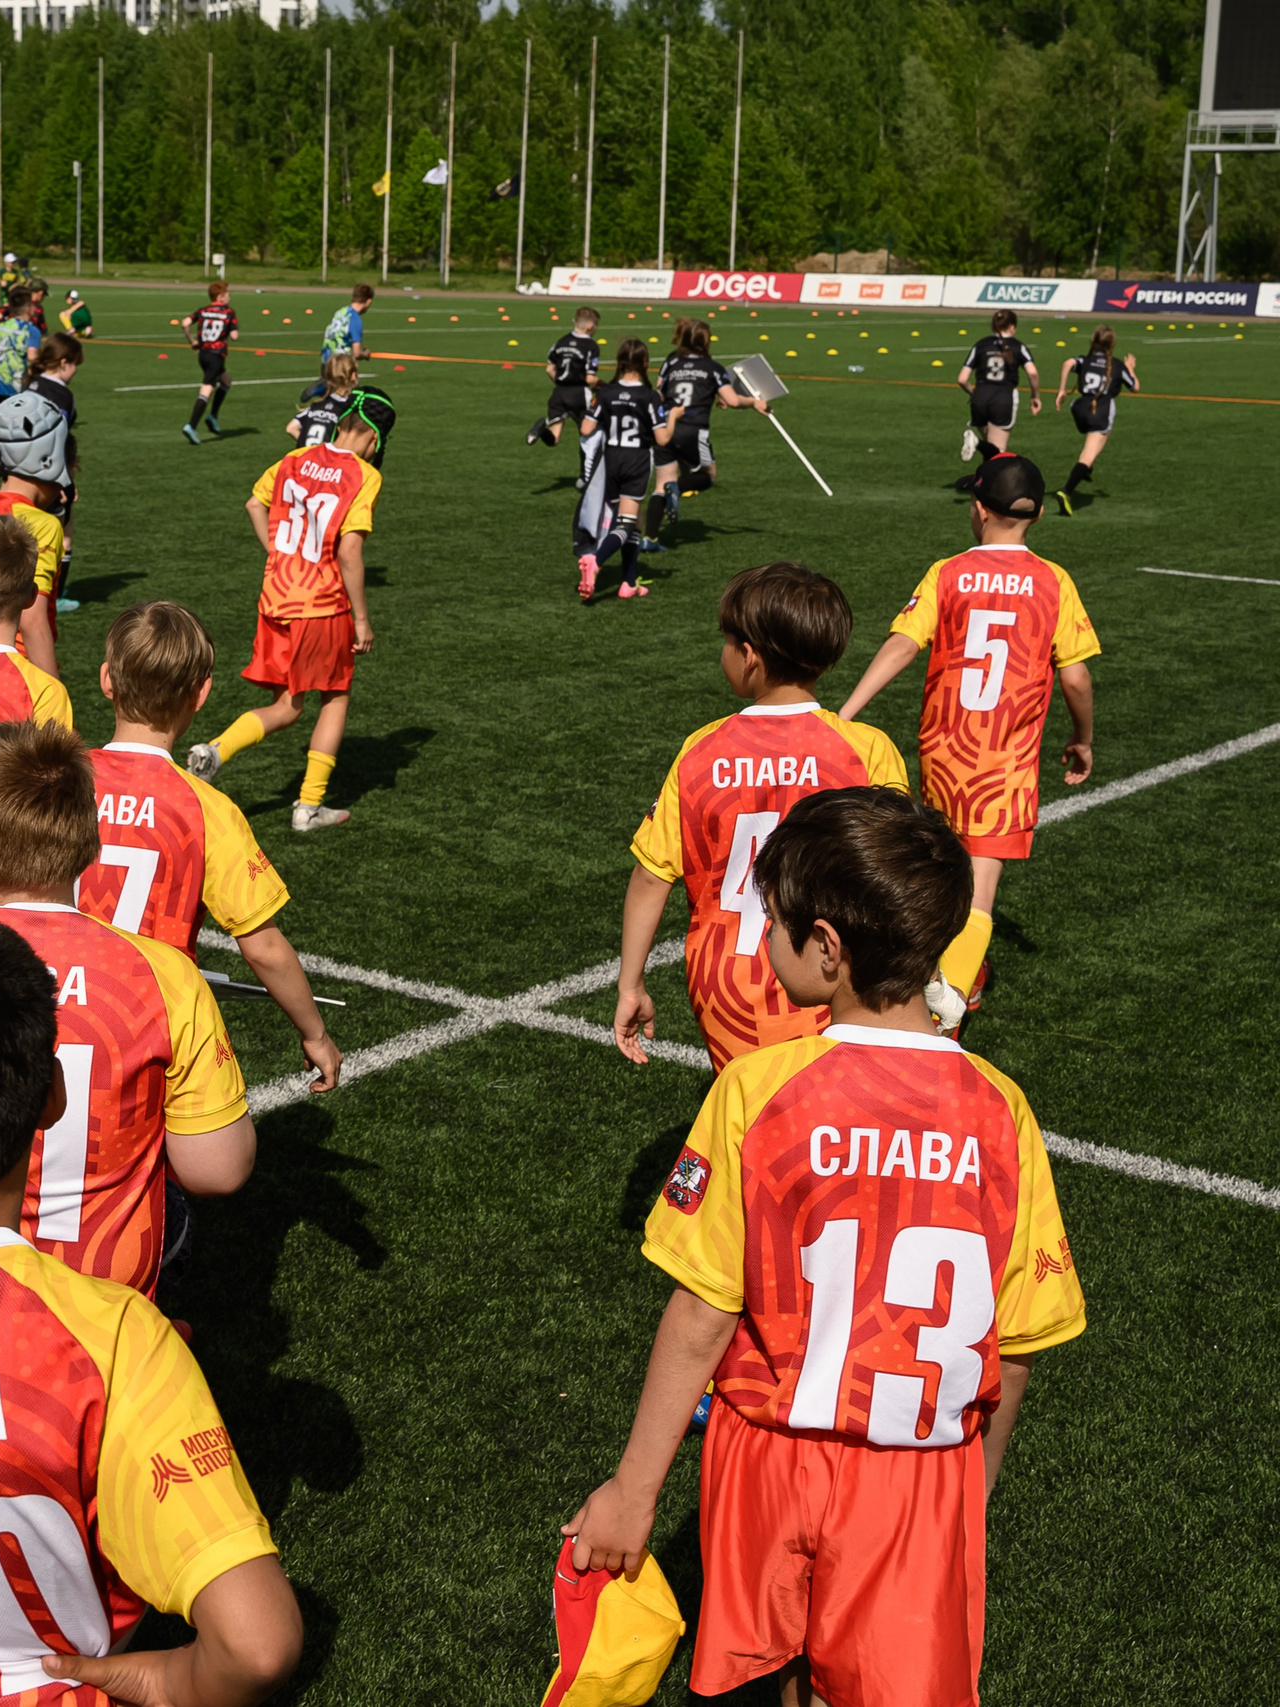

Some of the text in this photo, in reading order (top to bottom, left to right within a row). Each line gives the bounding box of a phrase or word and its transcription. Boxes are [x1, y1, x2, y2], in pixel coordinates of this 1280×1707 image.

[985, 284, 1051, 302] LANCET
[1135, 289, 1248, 306] РЕГБИ РОССИИ
[607, 414, 641, 448] 12
[299, 459, 343, 485] СЛАВА
[274, 477, 340, 564] 30
[957, 571, 1035, 598] СЛАВА
[959, 608, 1018, 711] 5
[711, 756, 820, 789] СЛАВА
[95, 792, 155, 829] АВА
[73, 843, 161, 936] 7
[719, 811, 782, 957] 4
[808, 1124, 982, 1188] СЛАВА
[788, 1217, 997, 1449] 13
